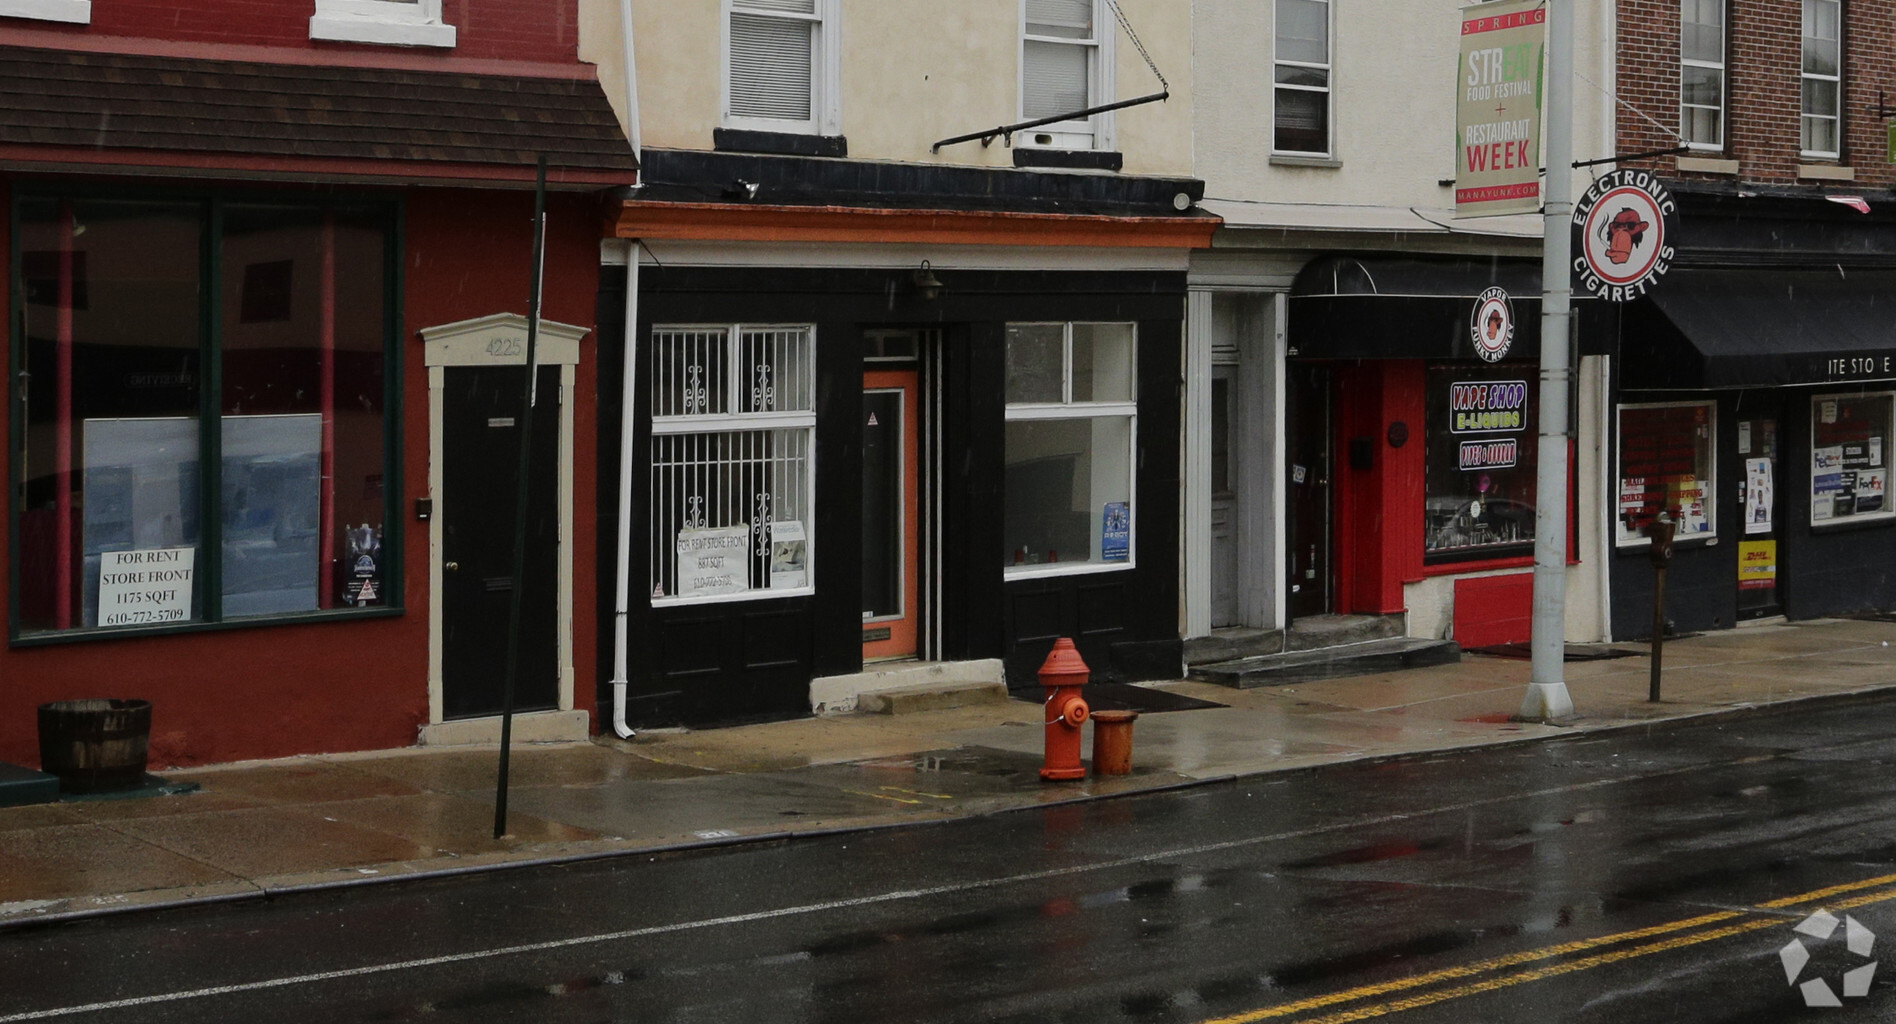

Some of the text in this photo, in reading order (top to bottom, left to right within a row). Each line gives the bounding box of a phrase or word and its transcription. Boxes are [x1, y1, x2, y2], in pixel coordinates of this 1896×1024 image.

[1464, 10, 1542, 33] SPRING
[1468, 42, 1533, 86] STREAT
[1467, 80, 1532, 102] FOOD FESTIVAL
[1466, 118, 1531, 145] RESTAURANT
[1466, 139, 1529, 173] WEEK
[1457, 186, 1537, 201] MANAYUNK.COM
[1573, 170, 1675, 226] ELECTRONIC
[1574, 245, 1675, 302] CIGARETTES
[1481, 288, 1507, 302] VAPOR
[485, 338, 521, 356] 4225
[1472, 323, 1515, 361] FUNKY MONKEY
[1453, 384, 1525, 411] VAPE SHOP
[1456, 411, 1520, 430] E-LIQUIDS
[678, 535, 747, 551] FOR RENT STORE FRONT
[116, 551, 181, 564] FOR RENT
[103, 569, 192, 585] STORE FRONT
[117, 590, 177, 605] 1175 SQFT
[107, 609, 183, 624] 610-772-5709
